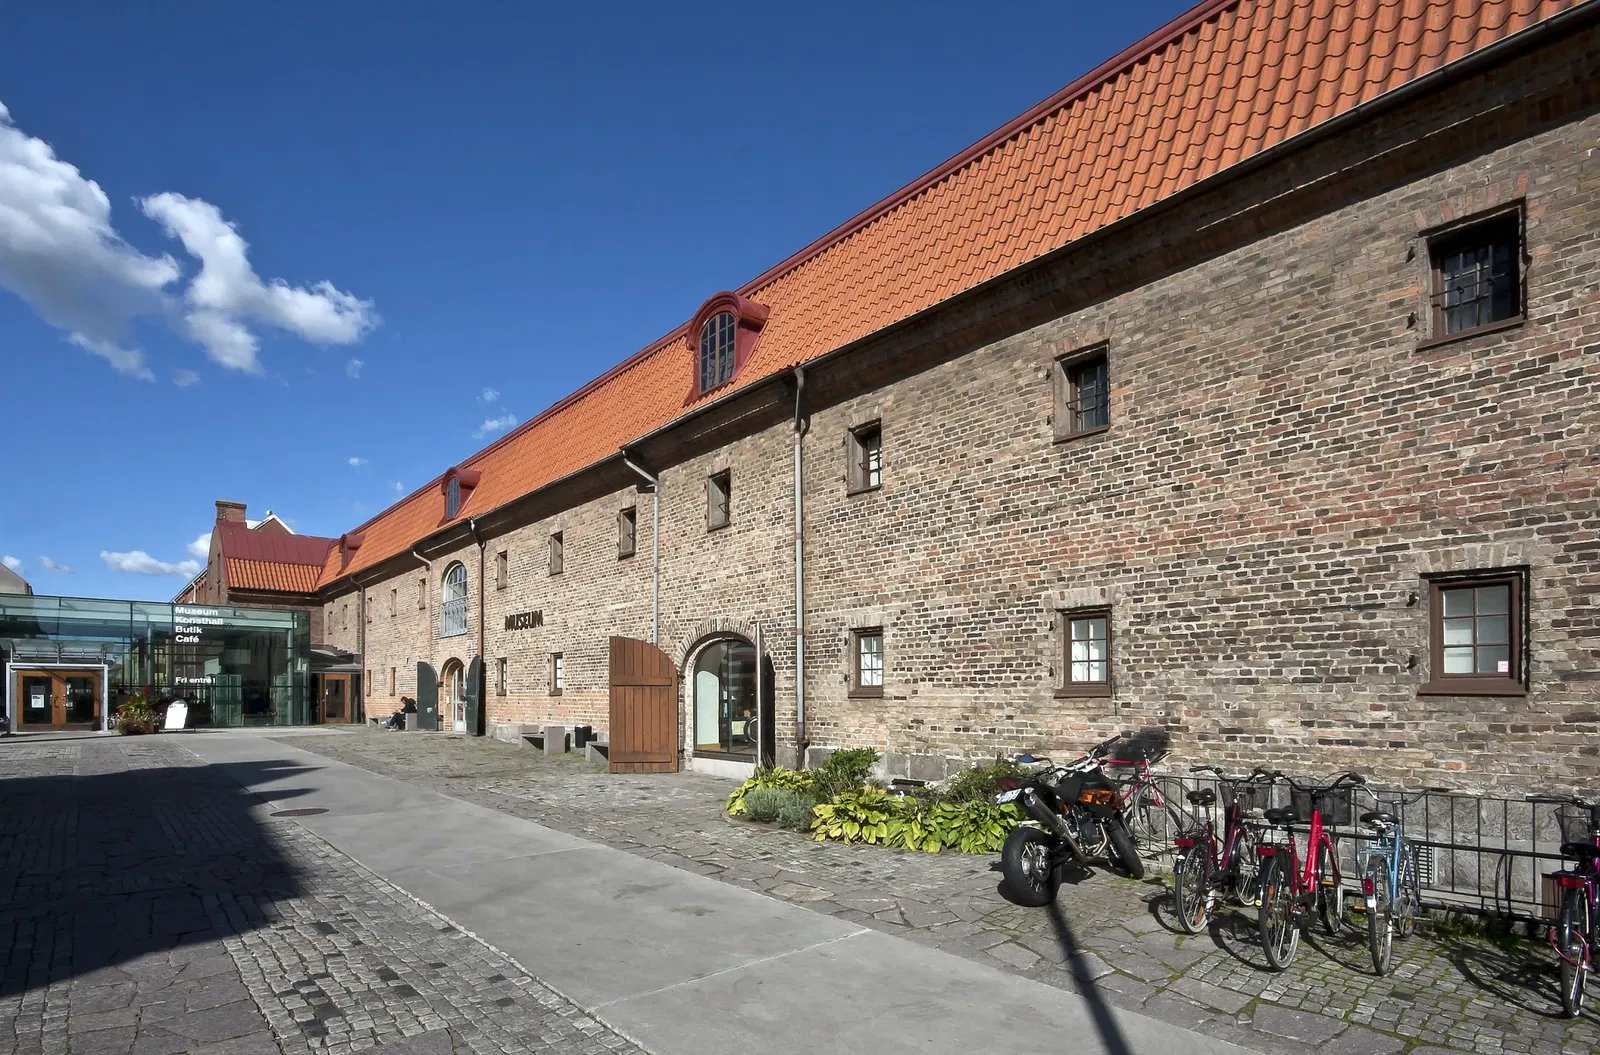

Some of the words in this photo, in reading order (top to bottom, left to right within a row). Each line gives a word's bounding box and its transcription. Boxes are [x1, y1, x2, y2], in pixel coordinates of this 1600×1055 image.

[175, 607, 218, 616] Museum
[175, 616, 224, 625] Konsthall
[505, 610, 543, 632] MUSEUM
[175, 625, 203, 634] Butik
[175, 635, 199, 643] Café
[175, 676, 187, 684] Fri
